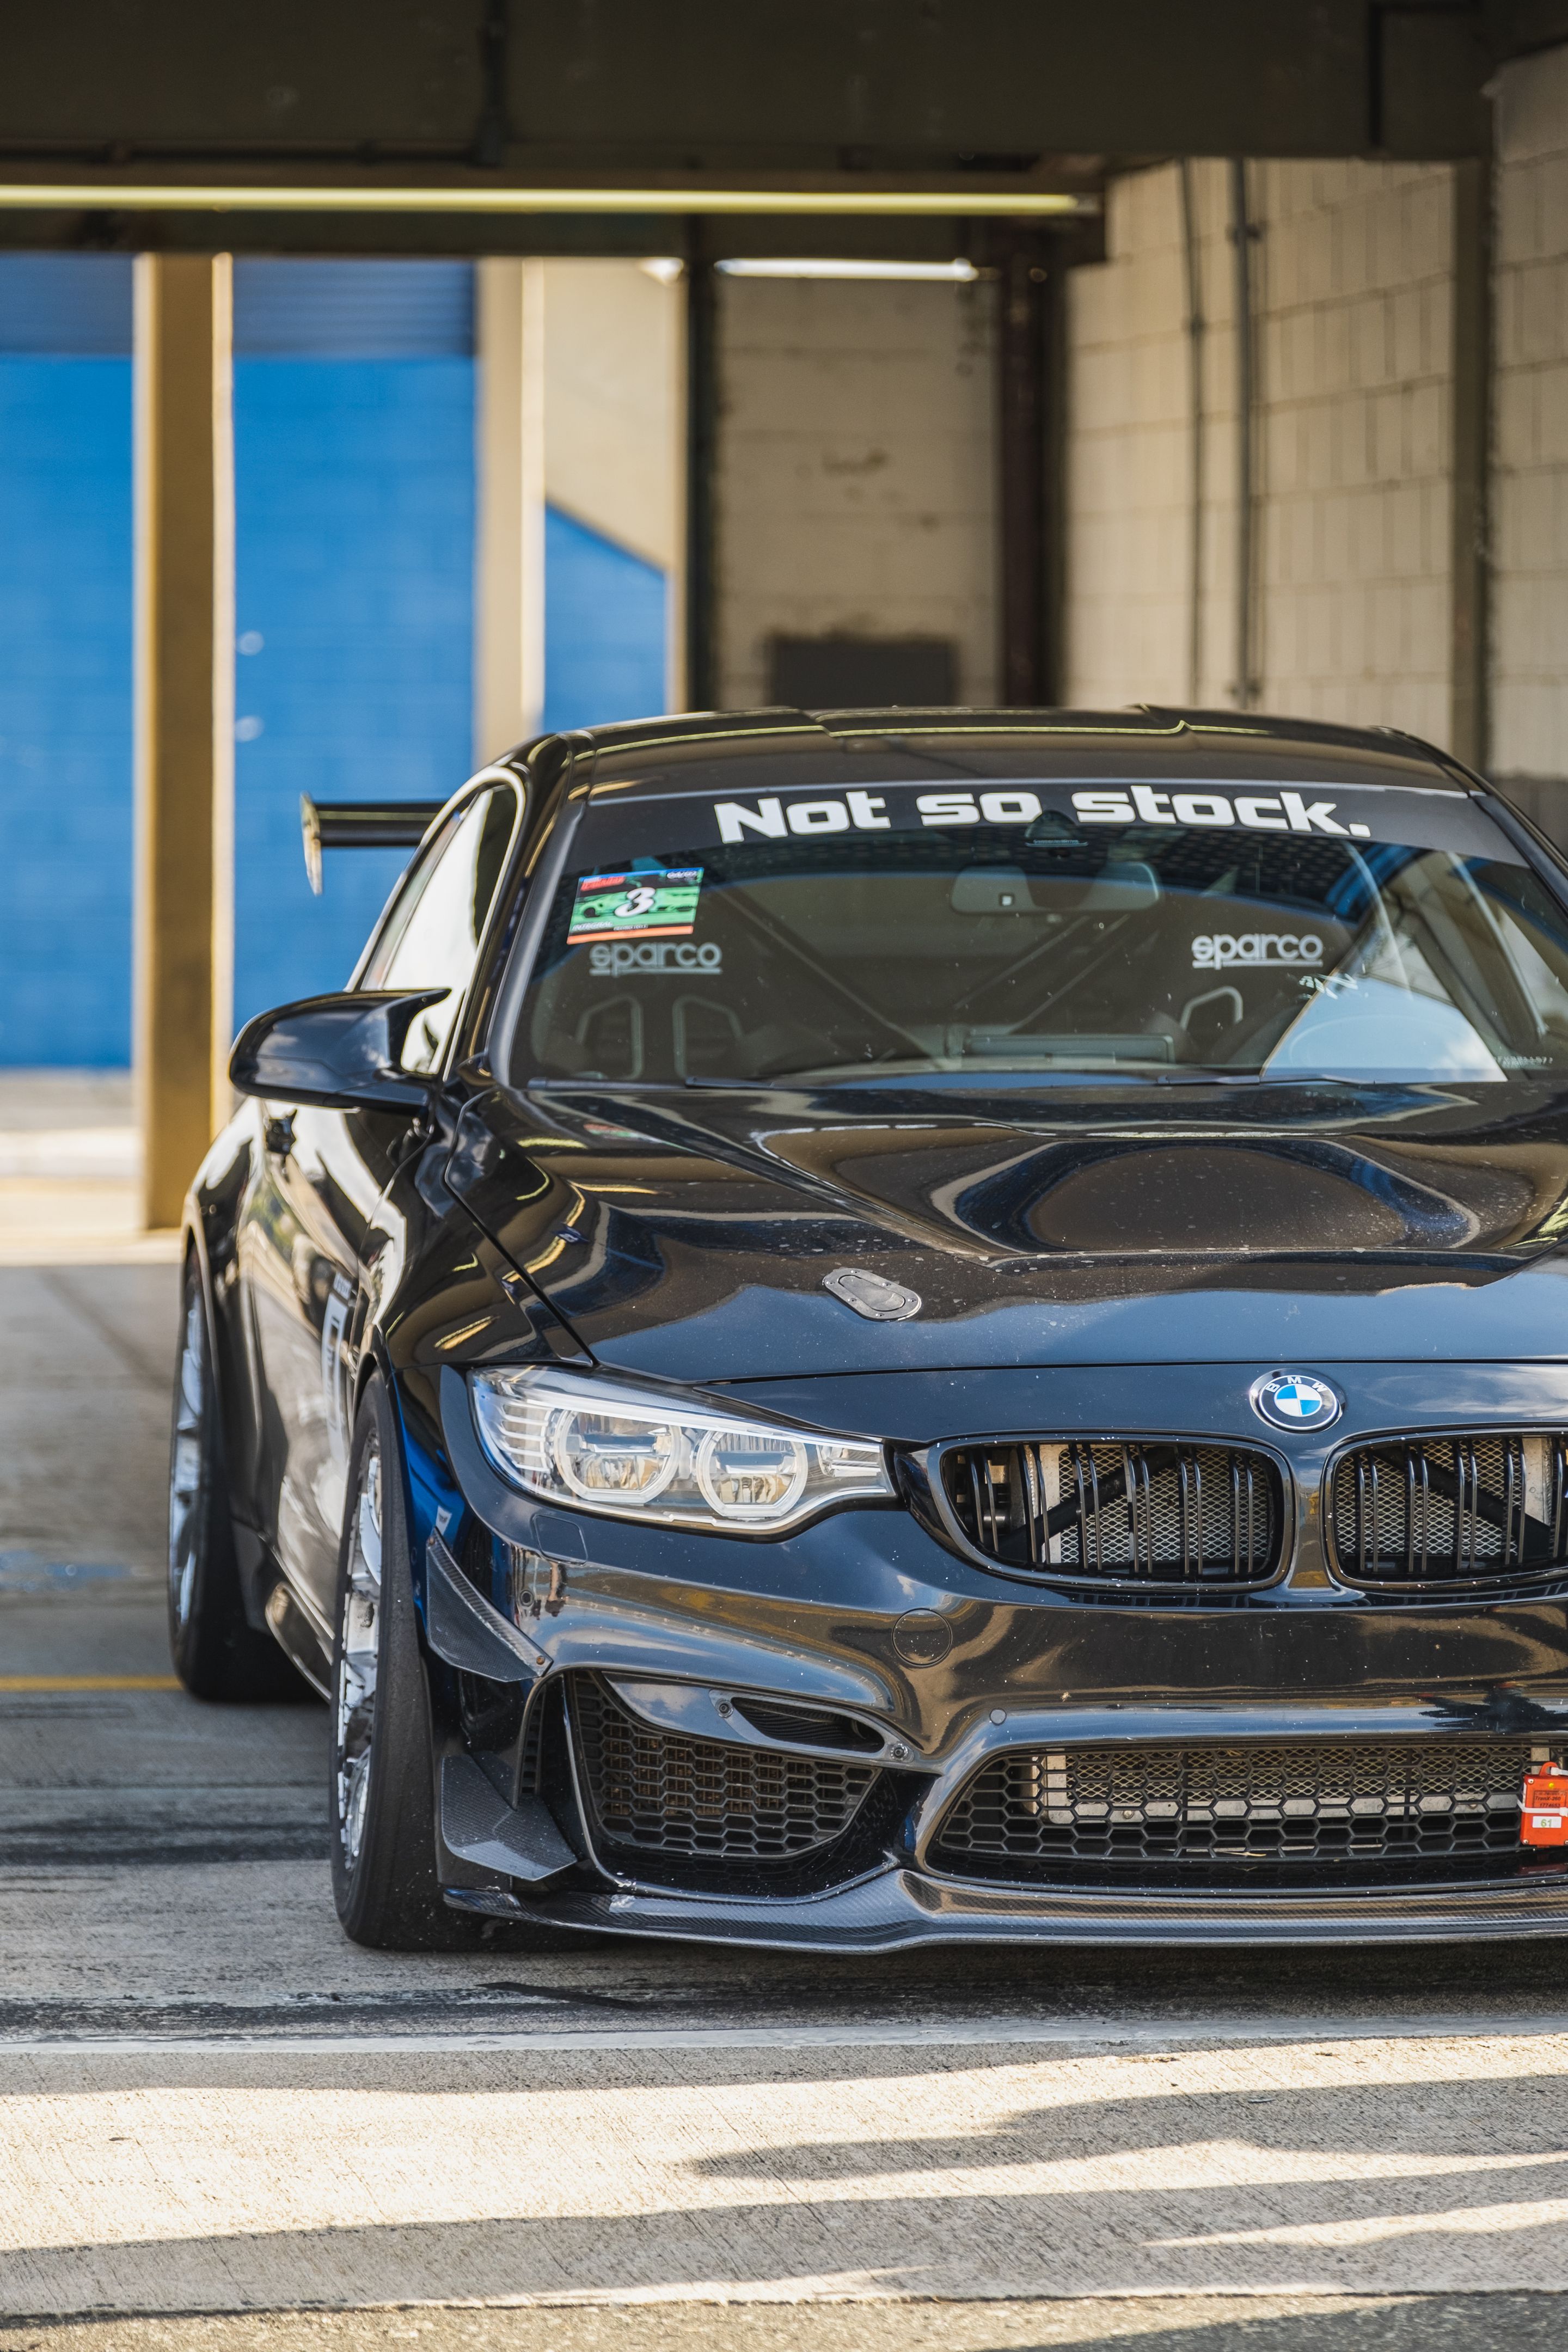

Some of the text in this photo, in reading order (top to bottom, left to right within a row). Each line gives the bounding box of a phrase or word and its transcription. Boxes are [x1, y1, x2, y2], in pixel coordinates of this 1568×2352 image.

[713, 785, 1371, 844] Not so stock.
[615, 887, 656, 917] 3
[590, 942, 722, 977] sparco
[1191, 934, 1324, 970] sparco
[1265, 1376, 1327, 1393] BMW
[1541, 1819, 1552, 1827] 61
